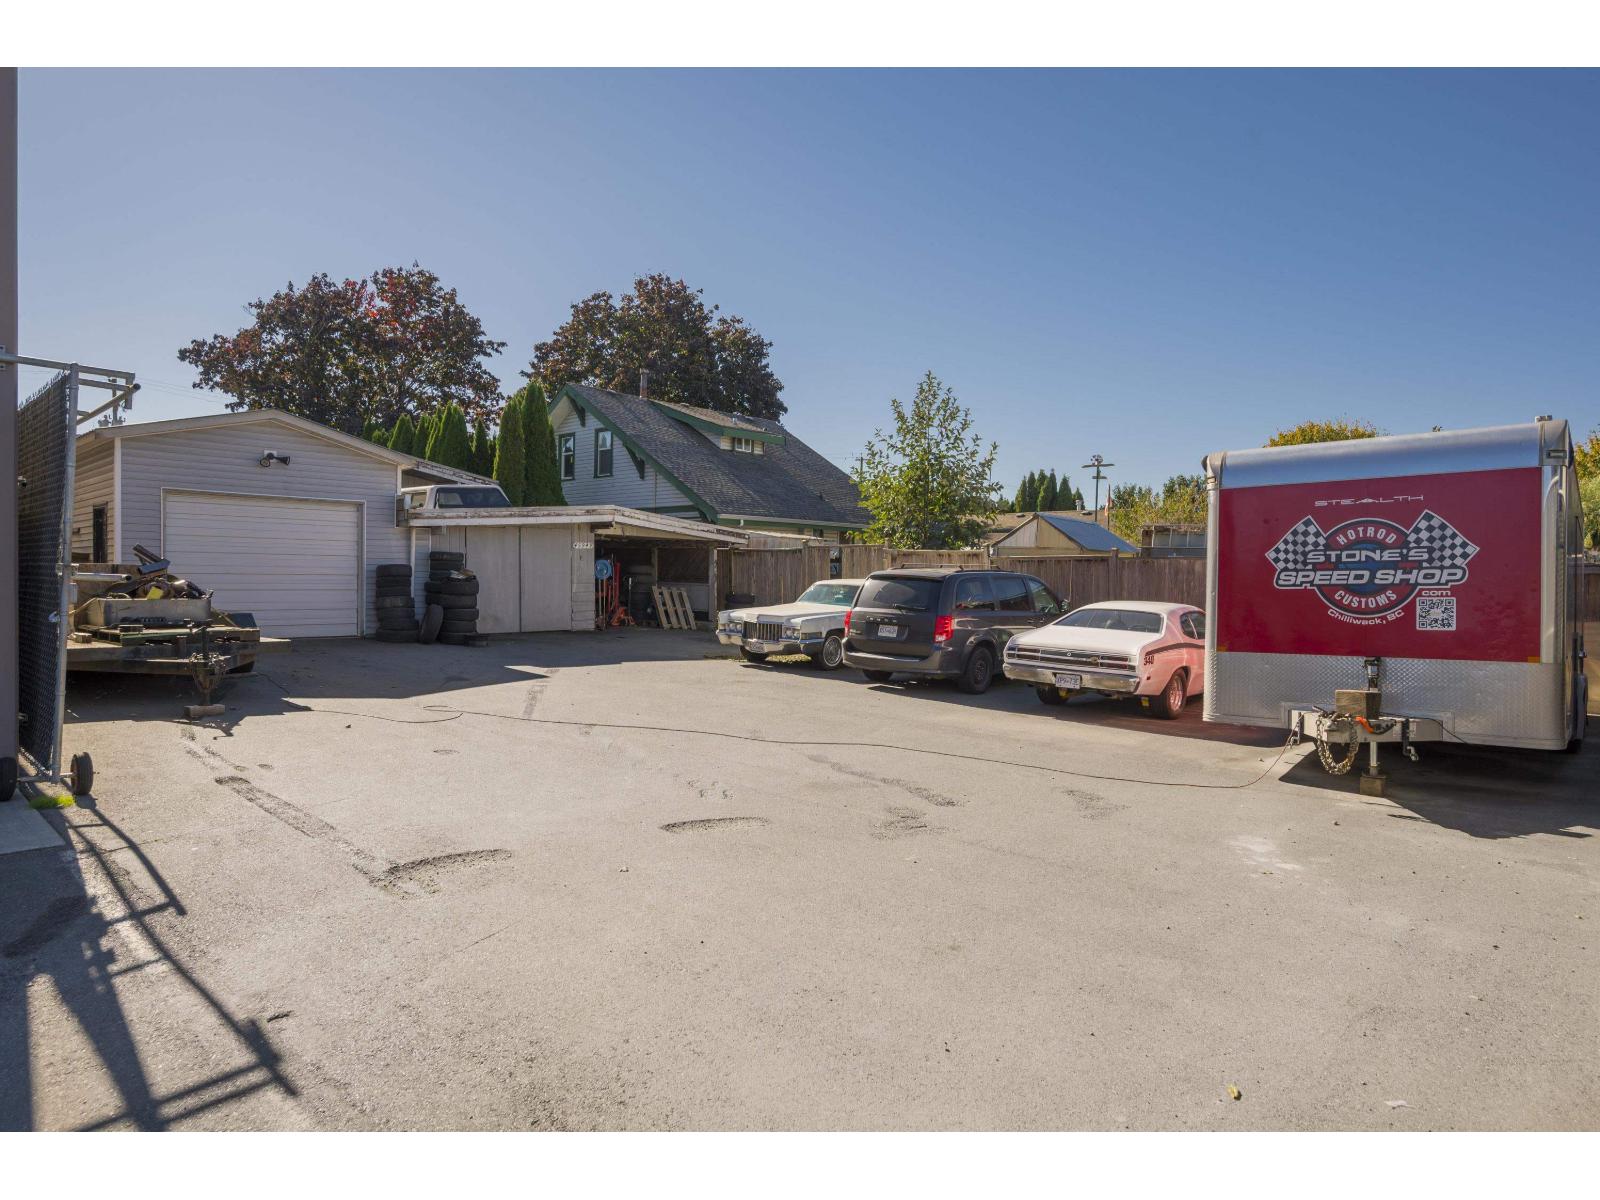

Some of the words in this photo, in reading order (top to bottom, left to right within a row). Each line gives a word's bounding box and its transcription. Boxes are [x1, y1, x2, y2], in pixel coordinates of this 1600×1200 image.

[1314, 495, 1424, 507] STEALTH
[1336, 526, 1397, 546] HOTROD
[1306, 548, 1429, 563] STONE'S
[1278, 570, 1370, 585] SPEED
[1375, 567, 1464, 584] SHOP
[1334, 590, 1397, 609] CUSTOMS
[1388, 609, 1405, 621] BC
[1143, 655, 1155, 666] 340
